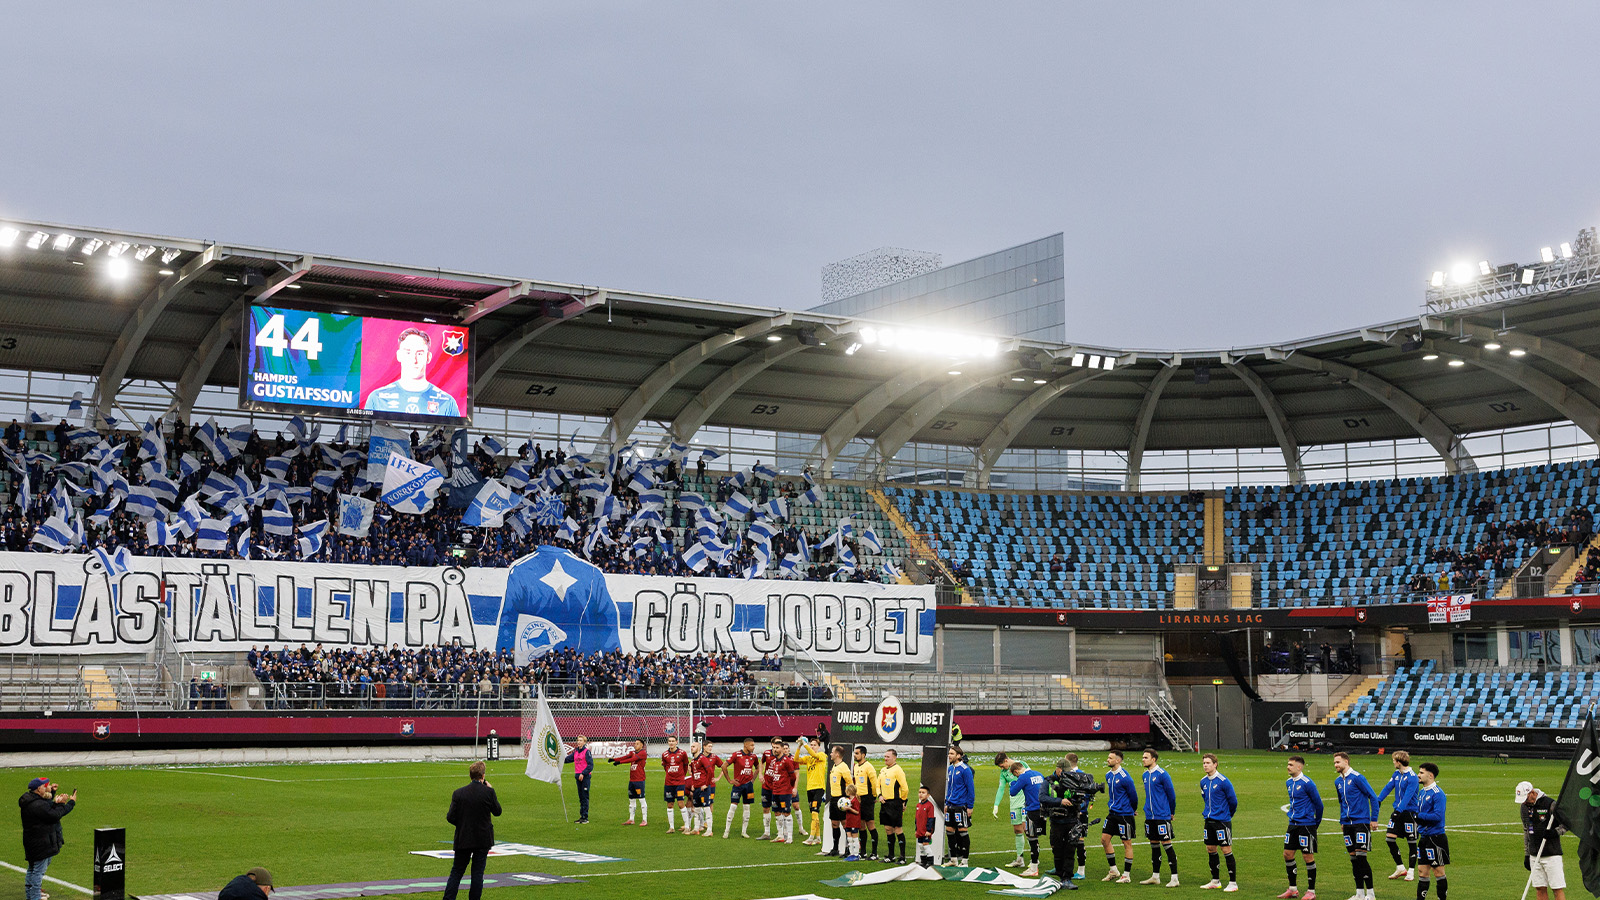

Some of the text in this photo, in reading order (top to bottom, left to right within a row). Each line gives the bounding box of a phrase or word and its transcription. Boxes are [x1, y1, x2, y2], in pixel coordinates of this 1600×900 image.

[254, 313, 323, 361] 44
[254, 371, 298, 384] HAMPUS
[253, 383, 354, 404] GUSTAFSSON
[525, 384, 558, 397] B4
[750, 404, 780, 415] B3
[1488, 401, 1521, 413] D2
[930, 420, 959, 431] B2
[1342, 417, 1371, 429] D1
[1049, 426, 1075, 436] B1
[390, 456, 419, 477] IFK
[386, 469, 440, 504] NORRKÖPING
[490, 495, 506, 510] IFK
[1529, 566, 1543, 576] D2
[0, 555, 926, 655] BLÅSTÄLLEN PÅ GÖR JOBBET
[1159, 614, 1263, 624] LIRARNAS LAG
[837, 711, 870, 724] UNIBET
[910, 712, 945, 726] UNIBET
[1289, 730, 1326, 739] Gamla Ullevi
[1349, 731, 1388, 740] Gamla Ullevi
[1413, 732, 1455, 741] Gamla Ullevi
[1481, 734, 1525, 743] Gamla Ullevi
[103, 862, 124, 873] SELECT
